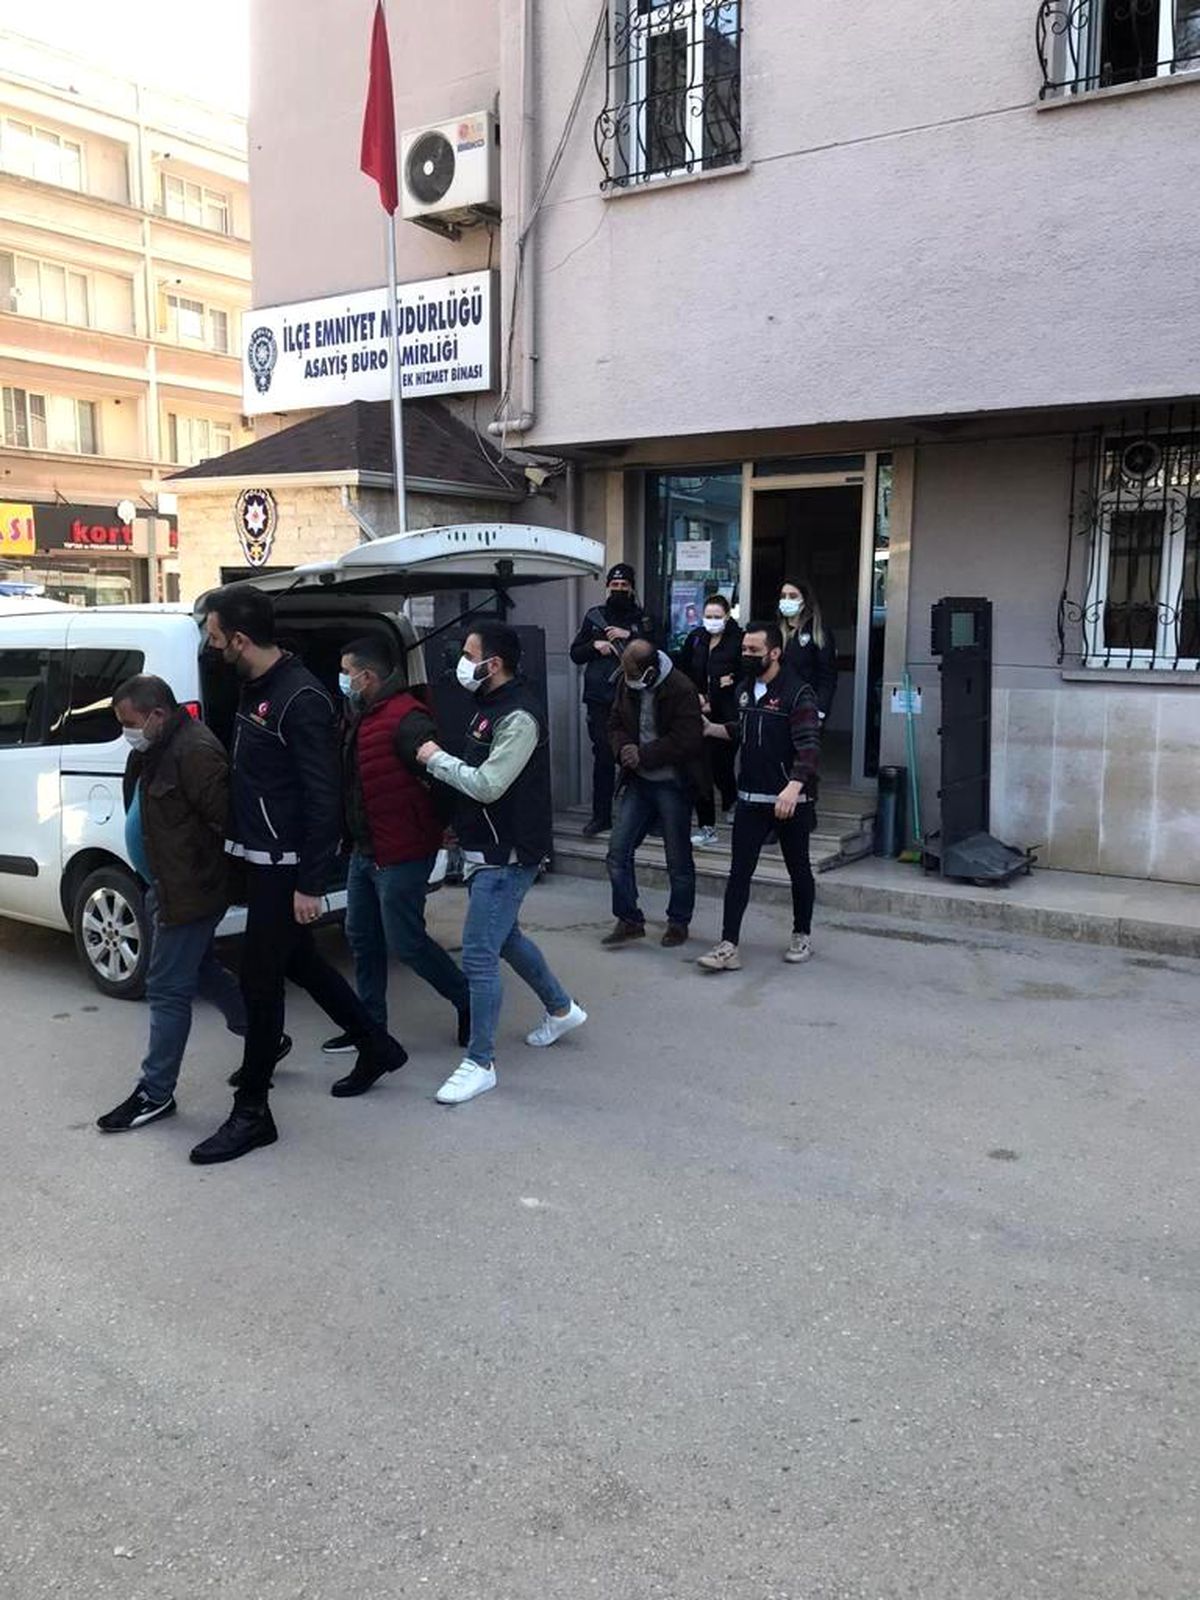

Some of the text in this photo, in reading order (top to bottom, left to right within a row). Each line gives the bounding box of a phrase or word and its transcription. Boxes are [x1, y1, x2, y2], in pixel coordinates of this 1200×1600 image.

[283, 318, 311, 359] İLÇE
[315, 307, 376, 348] EMNİYET
[304, 333, 458, 380] ASAYİŞ BÜRO MİRLİĞİ
[403, 362, 482, 387] EK HİZMET BİNASI
